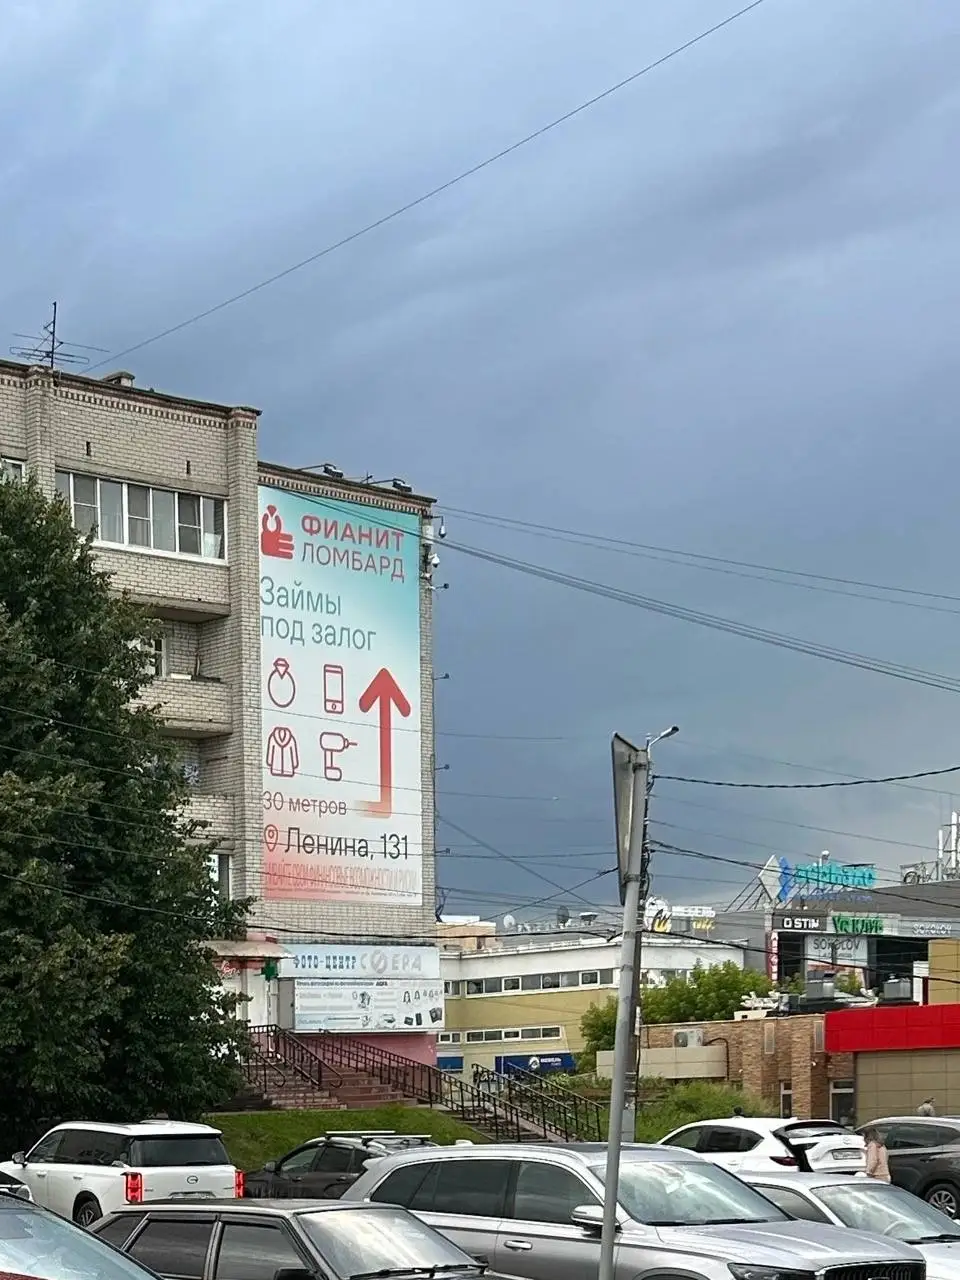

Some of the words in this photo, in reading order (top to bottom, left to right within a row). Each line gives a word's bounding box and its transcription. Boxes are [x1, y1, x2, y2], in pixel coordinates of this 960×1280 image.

[301, 515, 404, 552] ФИАНИТ
[301, 542, 405, 583] ЛОМБАРД
[260, 576, 341, 616] Займы
[261, 616, 305, 646] под
[311, 622, 376, 651] залог
[263, 791, 284, 811] 30
[289, 797, 347, 816] метров
[285, 827, 375, 860] Ленина,
[380, 834, 409, 861] 131
[813, 938, 860, 950] SOKOLOV
[293, 955, 356, 970] ФОТО-ЦЕНТР
